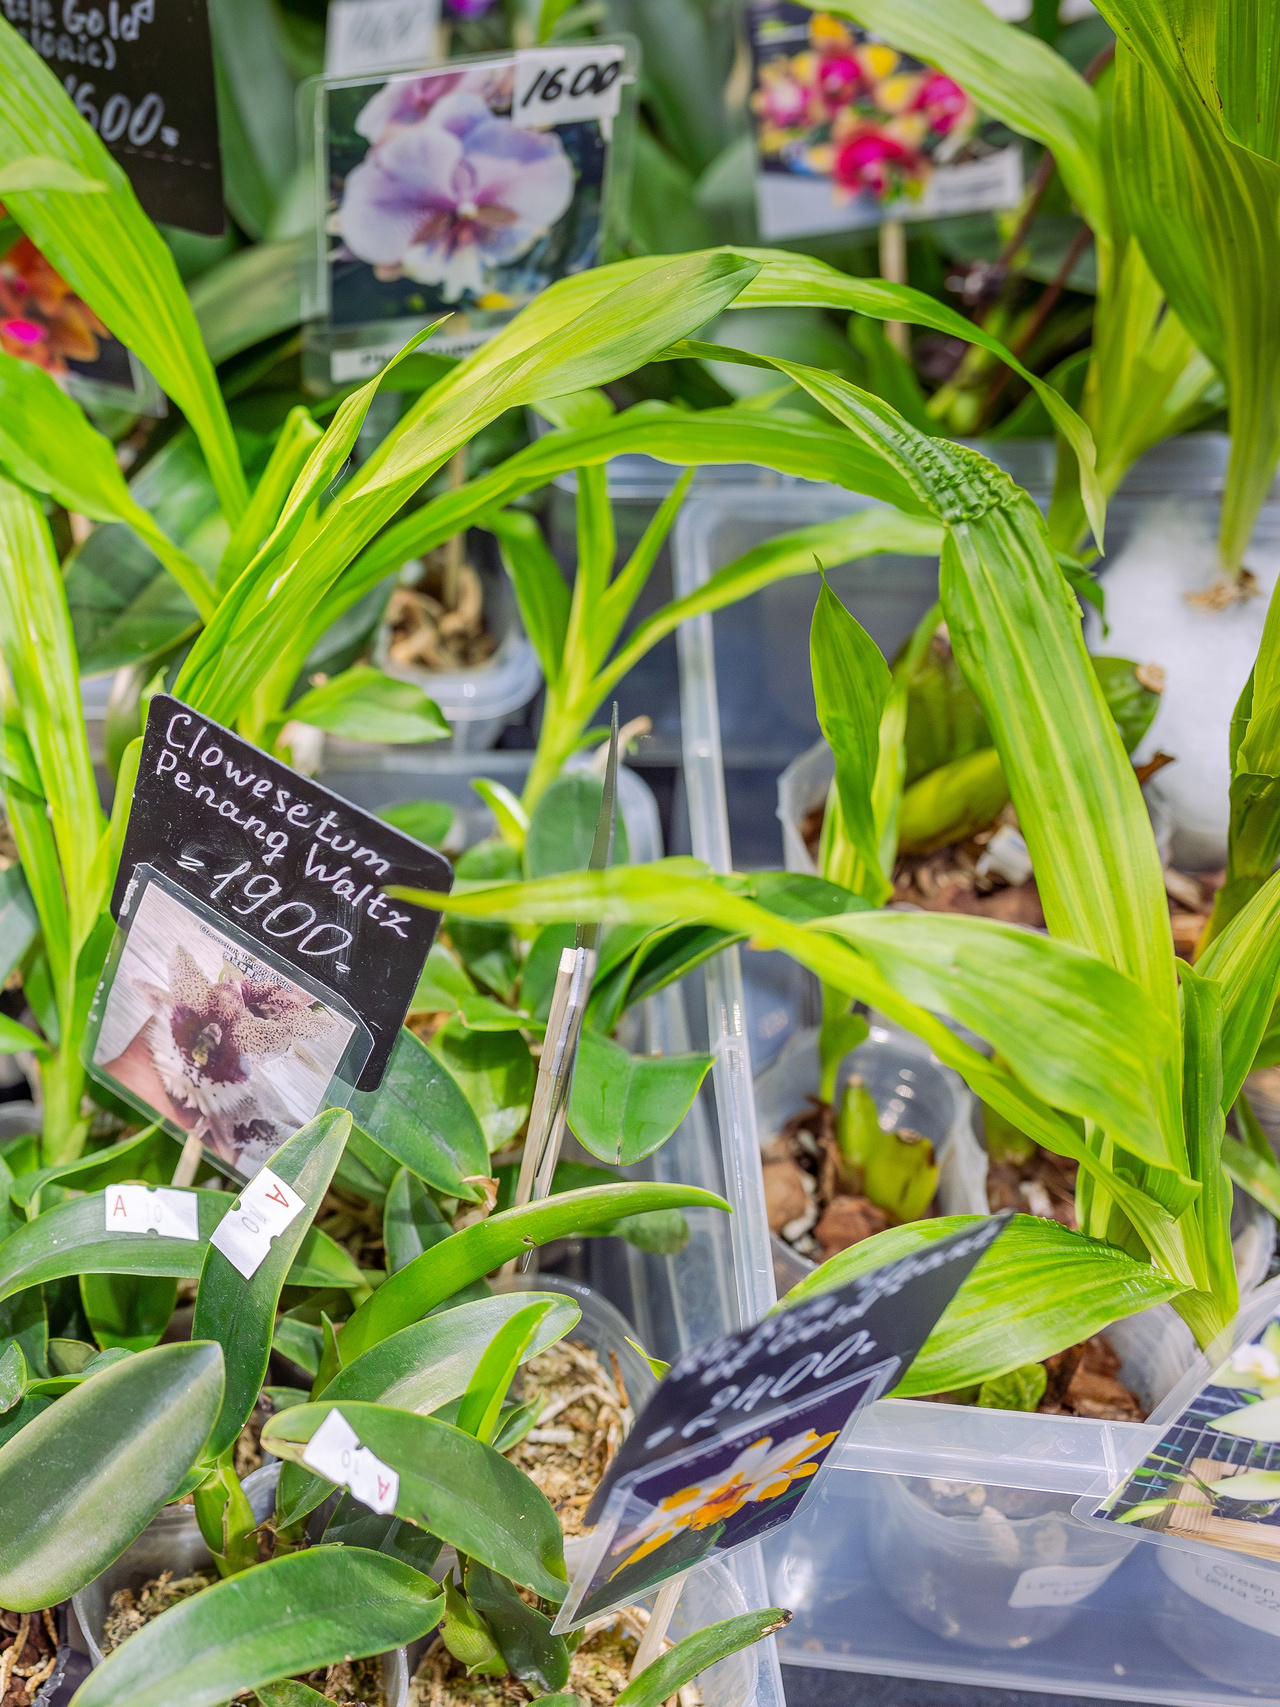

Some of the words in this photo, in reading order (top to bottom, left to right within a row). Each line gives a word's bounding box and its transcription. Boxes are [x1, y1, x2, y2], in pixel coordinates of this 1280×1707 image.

[522, 60, 621, 106] 1600
[166, 713, 391, 876] Clowesetum
[156, 749, 290, 866] Penang
[305, 842, 412, 938] Waltz
[113, 1195, 127, 1217] A
[265, 1184, 289, 1208] A
[377, 1474, 391, 1501] A
